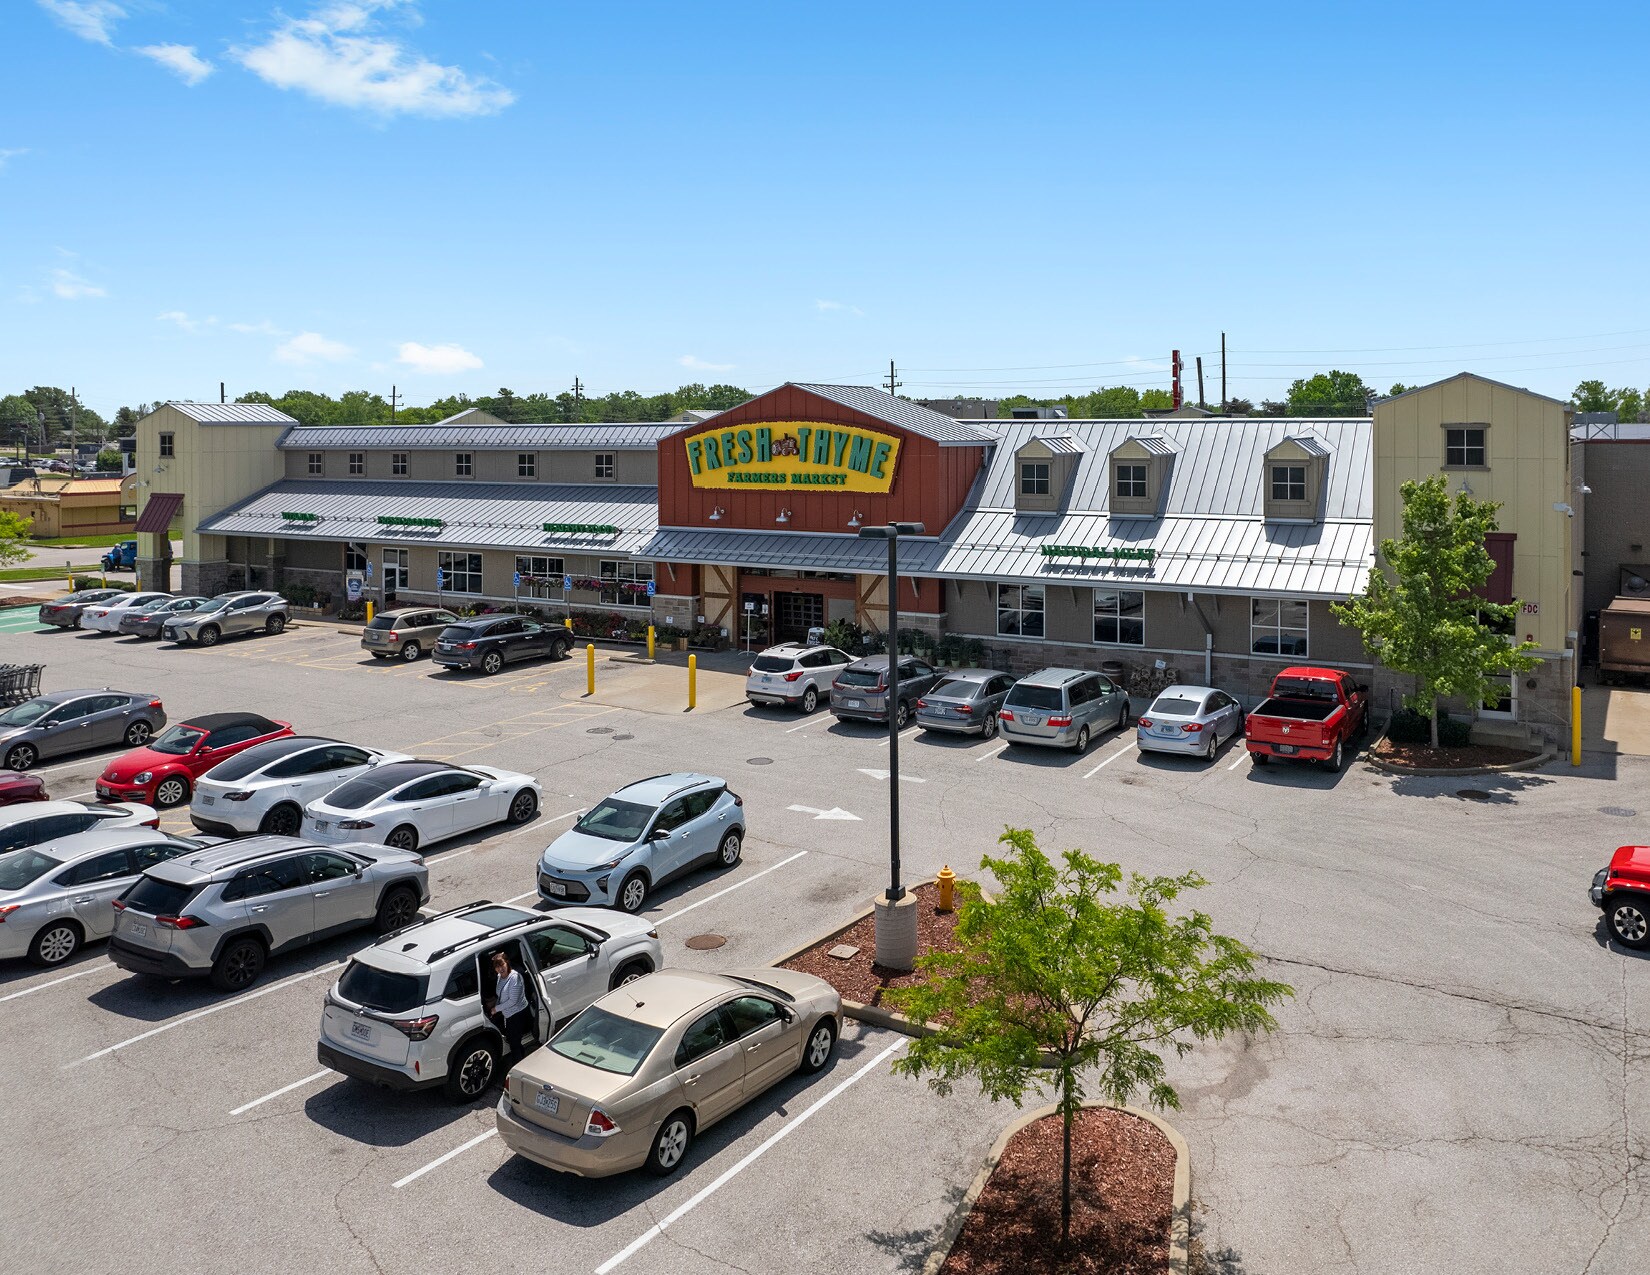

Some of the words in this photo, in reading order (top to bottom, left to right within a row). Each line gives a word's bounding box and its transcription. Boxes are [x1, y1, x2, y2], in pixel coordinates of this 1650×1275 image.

[688, 428, 772, 475] FRESH
[798, 428, 891, 479] THYME
[727, 472, 786, 484] FARMERS
[791, 473, 847, 485] MARKET
[1041, 545, 1108, 559] NATURAL
[1113, 547, 1156, 560] MEAT
[1522, 604, 1538, 613] FDC
